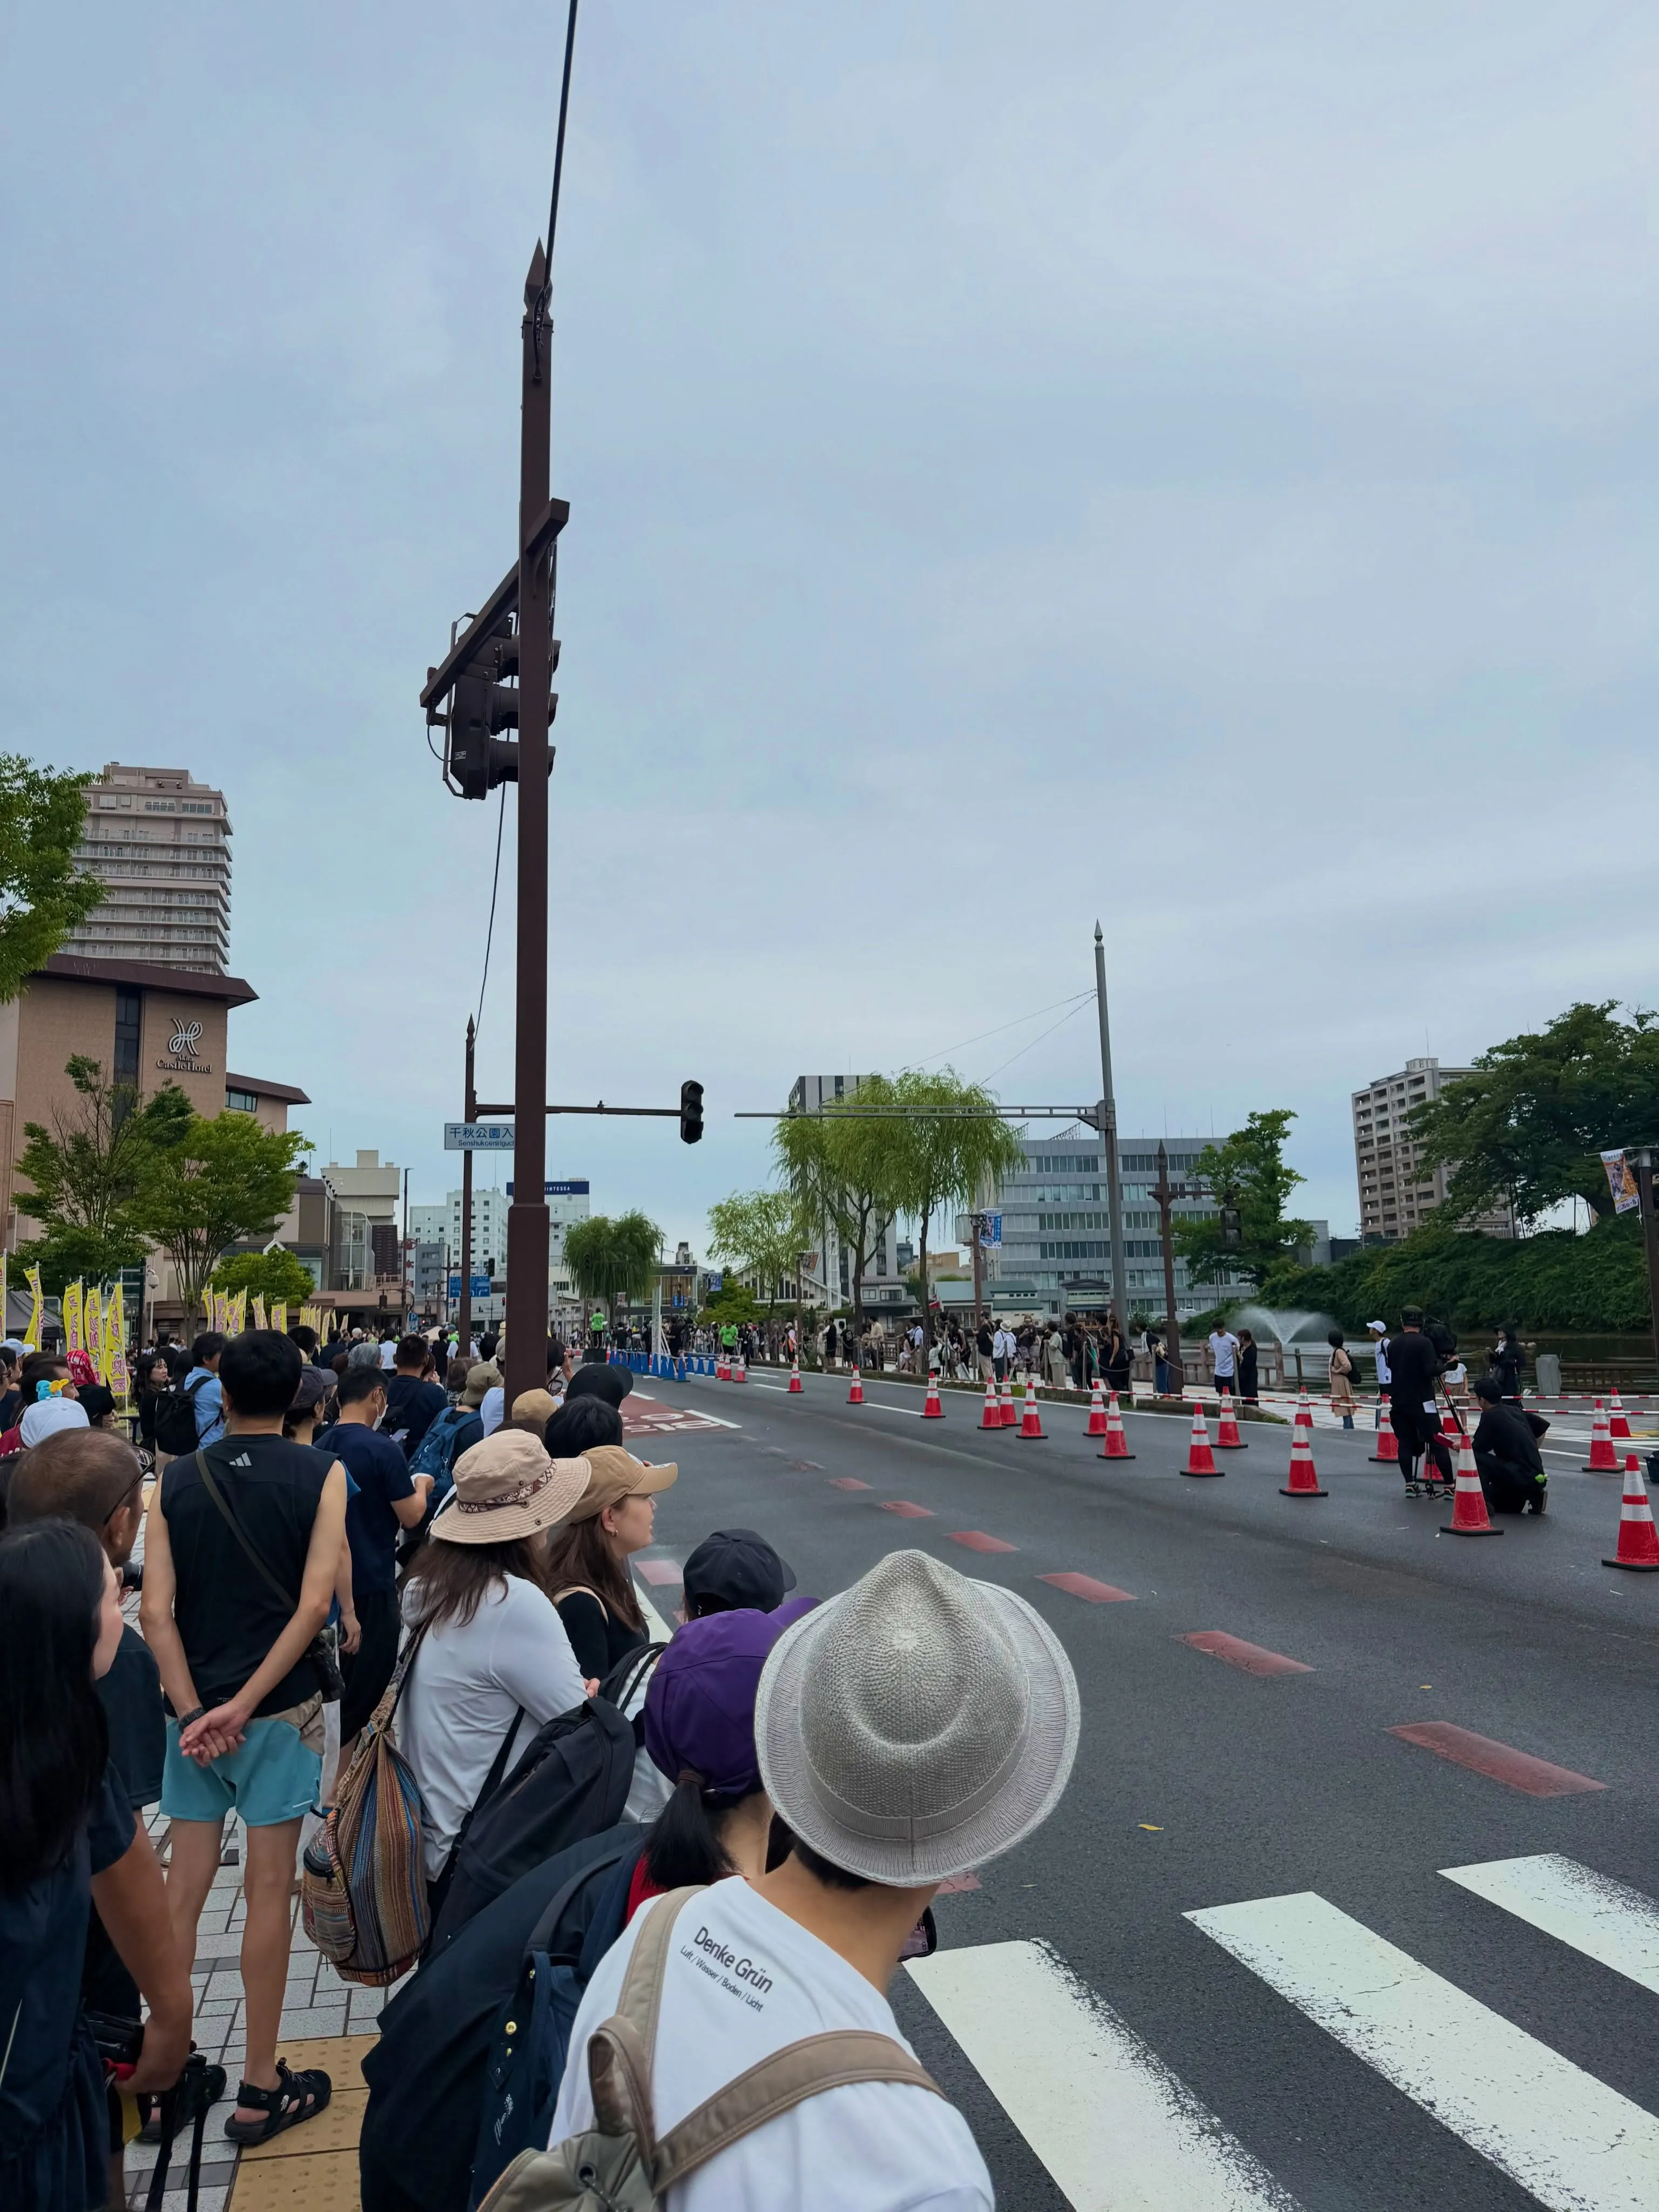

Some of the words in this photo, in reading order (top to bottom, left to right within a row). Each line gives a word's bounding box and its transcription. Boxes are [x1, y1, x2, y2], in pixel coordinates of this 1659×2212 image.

[157, 1059, 185, 1070] Castle
[187, 1062, 212, 1073] Hotel
[680, 1945, 693, 1960] Luft
[696, 1957, 719, 1980] Wasser
[721, 1978, 743, 1998] Boden
[745, 1994, 764, 2013] Licht
[693, 1926, 736, 1968] Denke
[735, 1958, 773, 1994] Grün
